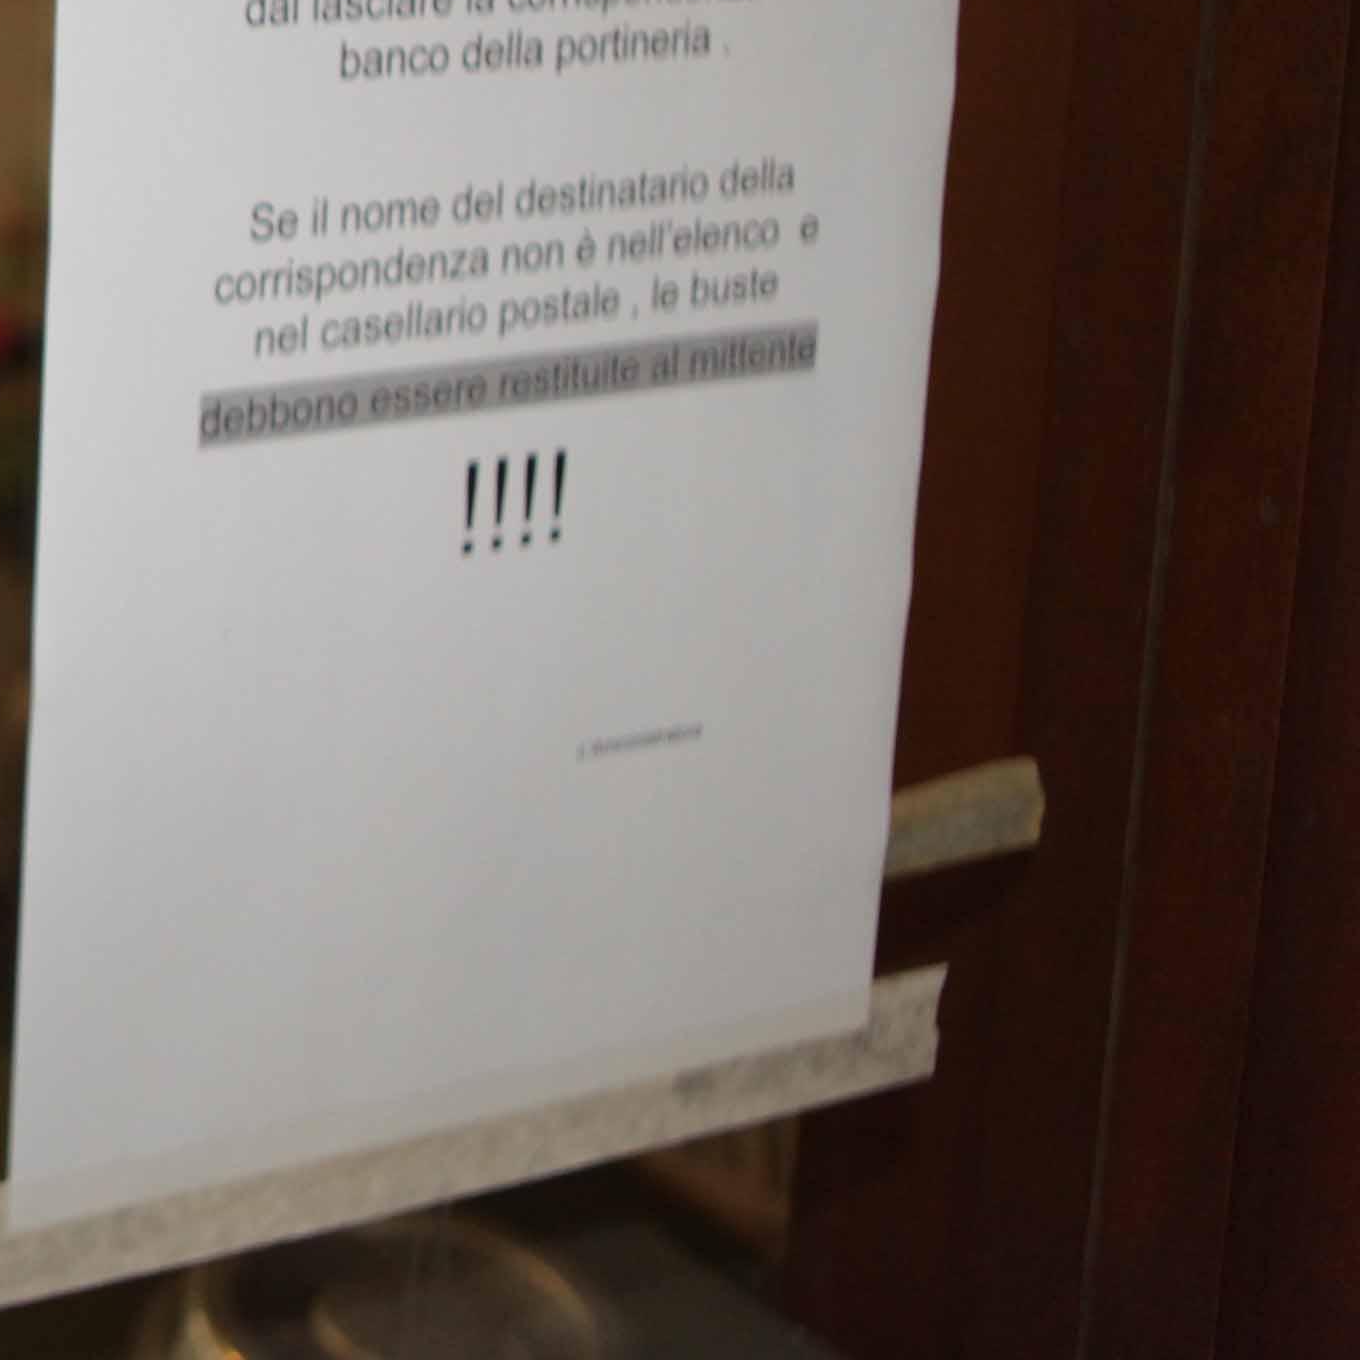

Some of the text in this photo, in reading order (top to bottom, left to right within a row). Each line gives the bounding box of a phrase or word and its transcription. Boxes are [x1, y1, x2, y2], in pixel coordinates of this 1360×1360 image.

[338, 39, 449, 81] banco
[461, 30, 544, 73] della
[554, 20, 712, 73] portineria
[250, 156, 796, 243] Se il nome del destinatario della
[214, 246, 489, 306] corrispondenza
[501, 237, 564, 275] non
[608, 214, 779, 263] nell'elenco
[799, 214, 821, 242] e
[254, 315, 309, 359] nel
[320, 296, 488, 352] casellario
[498, 280, 620, 338] postale
[652, 275, 679, 313] le
[690, 265, 779, 309] buste
[199, 328, 816, 440] debbono essere restituite al mittente
